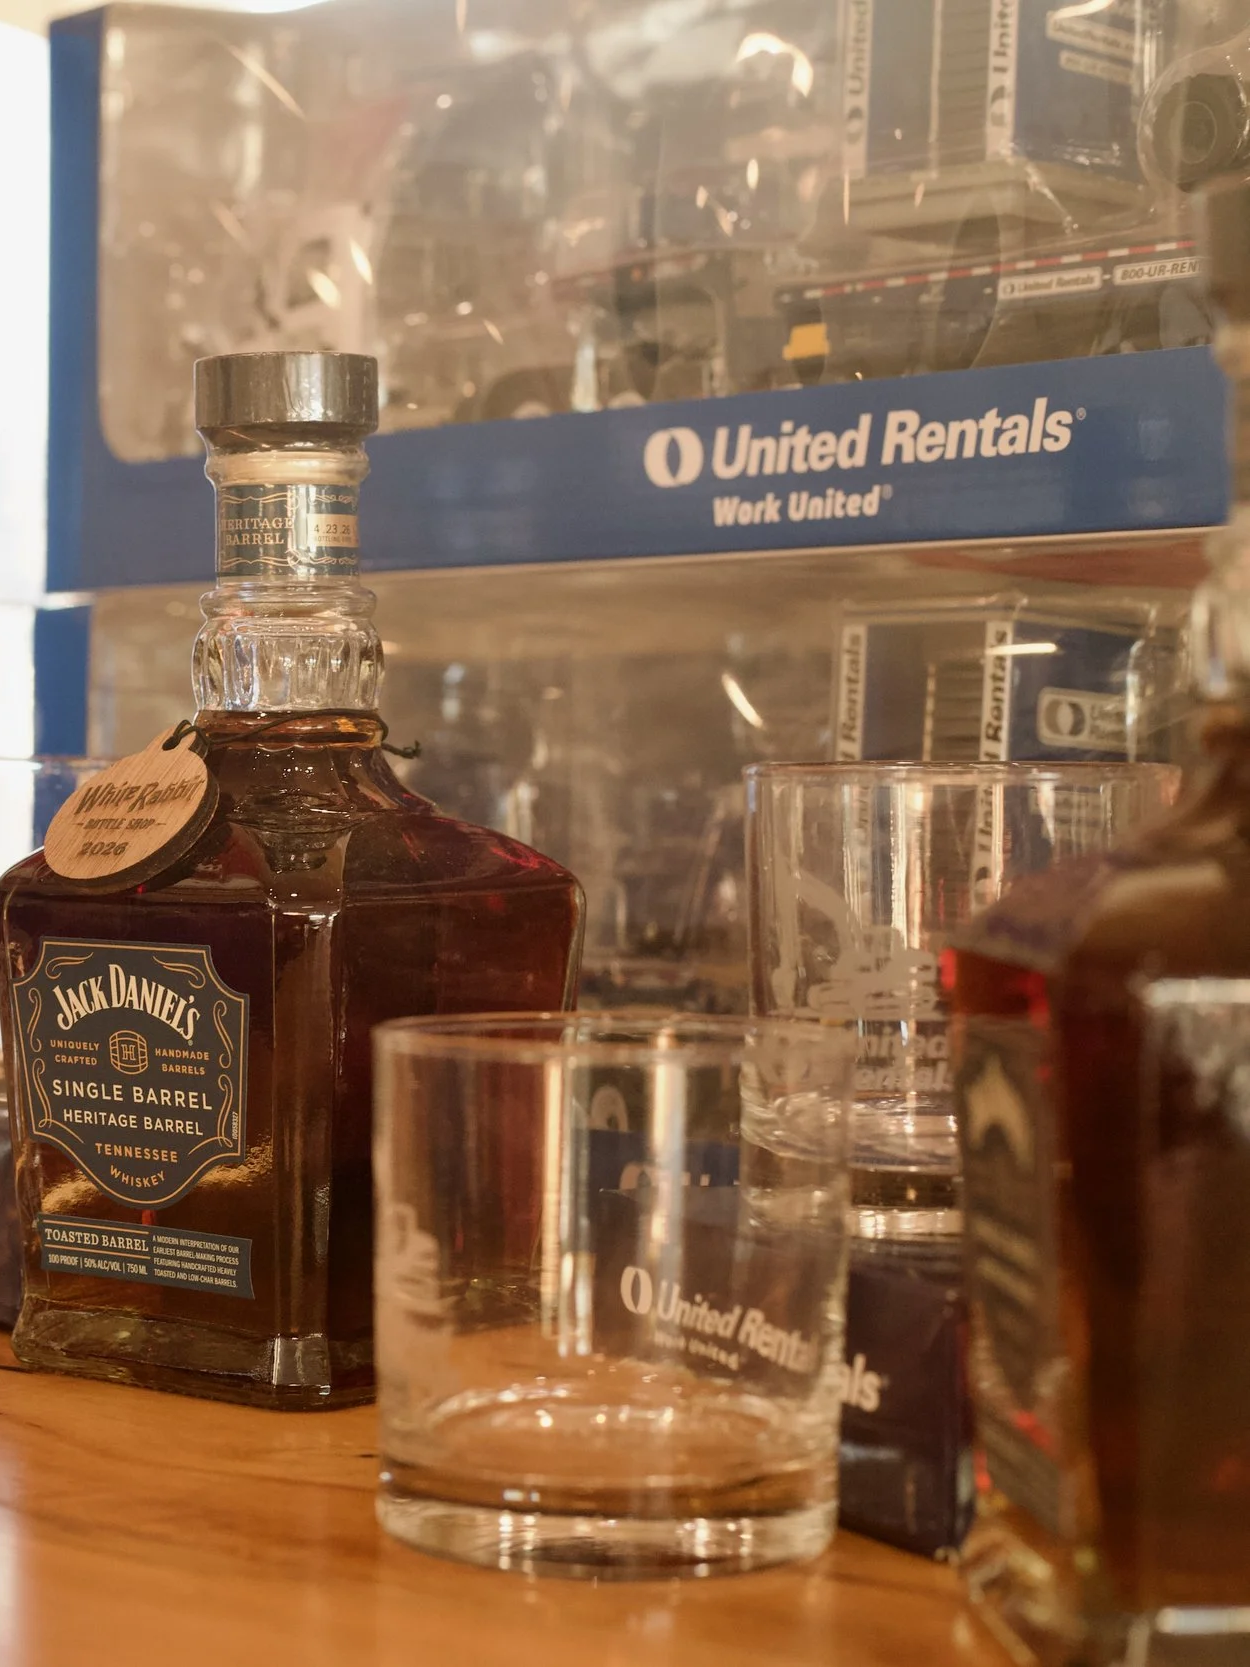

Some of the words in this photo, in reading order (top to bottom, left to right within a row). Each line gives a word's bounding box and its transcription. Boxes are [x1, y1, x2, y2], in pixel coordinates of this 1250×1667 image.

[711, 412, 872, 480] United
[881, 396, 1074, 466] Rentals
[712, 494, 781, 527] Work
[787, 484, 881, 521] United
[225, 532, 285, 546] BARREL
[74, 781, 141, 815] White
[128, 774, 206, 813] Rabbit
[83, 818, 124, 830] BOTTLE
[125, 818, 156, 830] SHOP
[78, 841, 130, 857] 2026
[52, 976, 109, 1030] JACK
[108, 964, 200, 1041] DANIEL'S
[50, 1039, 100, 1052] UNIQUELY
[155, 1047, 210, 1061] HANDMADE
[54, 1054, 97, 1066] CRAFTED
[161, 1063, 205, 1076] BARRELS
[52, 1079, 124, 1102] SINGLE
[132, 1085, 213, 1111] BARREL
[63, 1108, 138, 1129] HERITAGE
[143, 1116, 204, 1136] BARREL
[95, 1142, 178, 1164] TENNESSEE
[109, 1165, 166, 1189] WHISKEY
[44, 1228, 99, 1246] TOASTED
[102, 1234, 149, 1252] BARREL
[220, 1244, 227, 1252] OF
[48, 1254, 59, 1264] 100
[60, 1255, 79, 1266] PROOF
[84, 1257, 97, 1268] 50%
[97, 1259, 122, 1272] ALC/VOL
[126, 1263, 138, 1274] 750
[216, 1255, 239, 1265] PROCESS
[176, 1272, 188, 1281] AND
[656, 1279, 743, 1339] United
